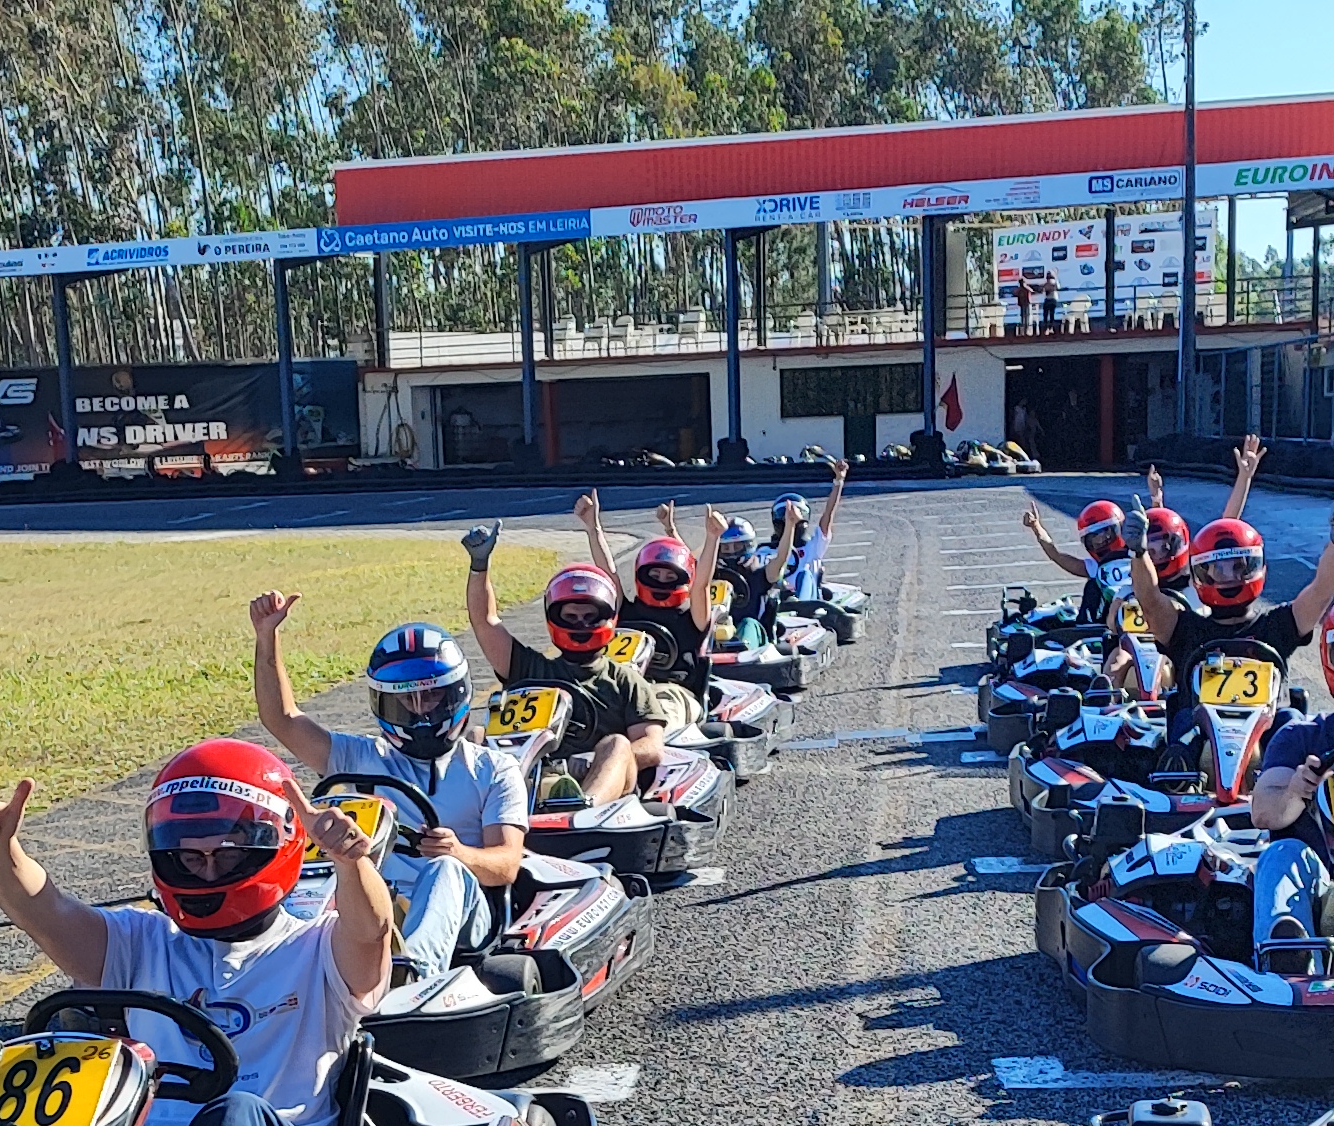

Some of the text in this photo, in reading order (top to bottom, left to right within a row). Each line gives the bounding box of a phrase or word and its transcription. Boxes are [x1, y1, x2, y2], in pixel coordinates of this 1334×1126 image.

[1115, 174, 1178, 190] CARIANO
[344, 216, 589, 247] Caetano Auto VISITE-NOS EM LEIRIA
[997, 229, 1071, 247] EUROINDY
[224, 243, 270, 255] PEREIRA
[75, 394, 190, 412] BECOME A
[125, 421, 228, 444] DRIVER
[499, 696, 539, 726] 65
[80, 1045, 112, 1061] 26
